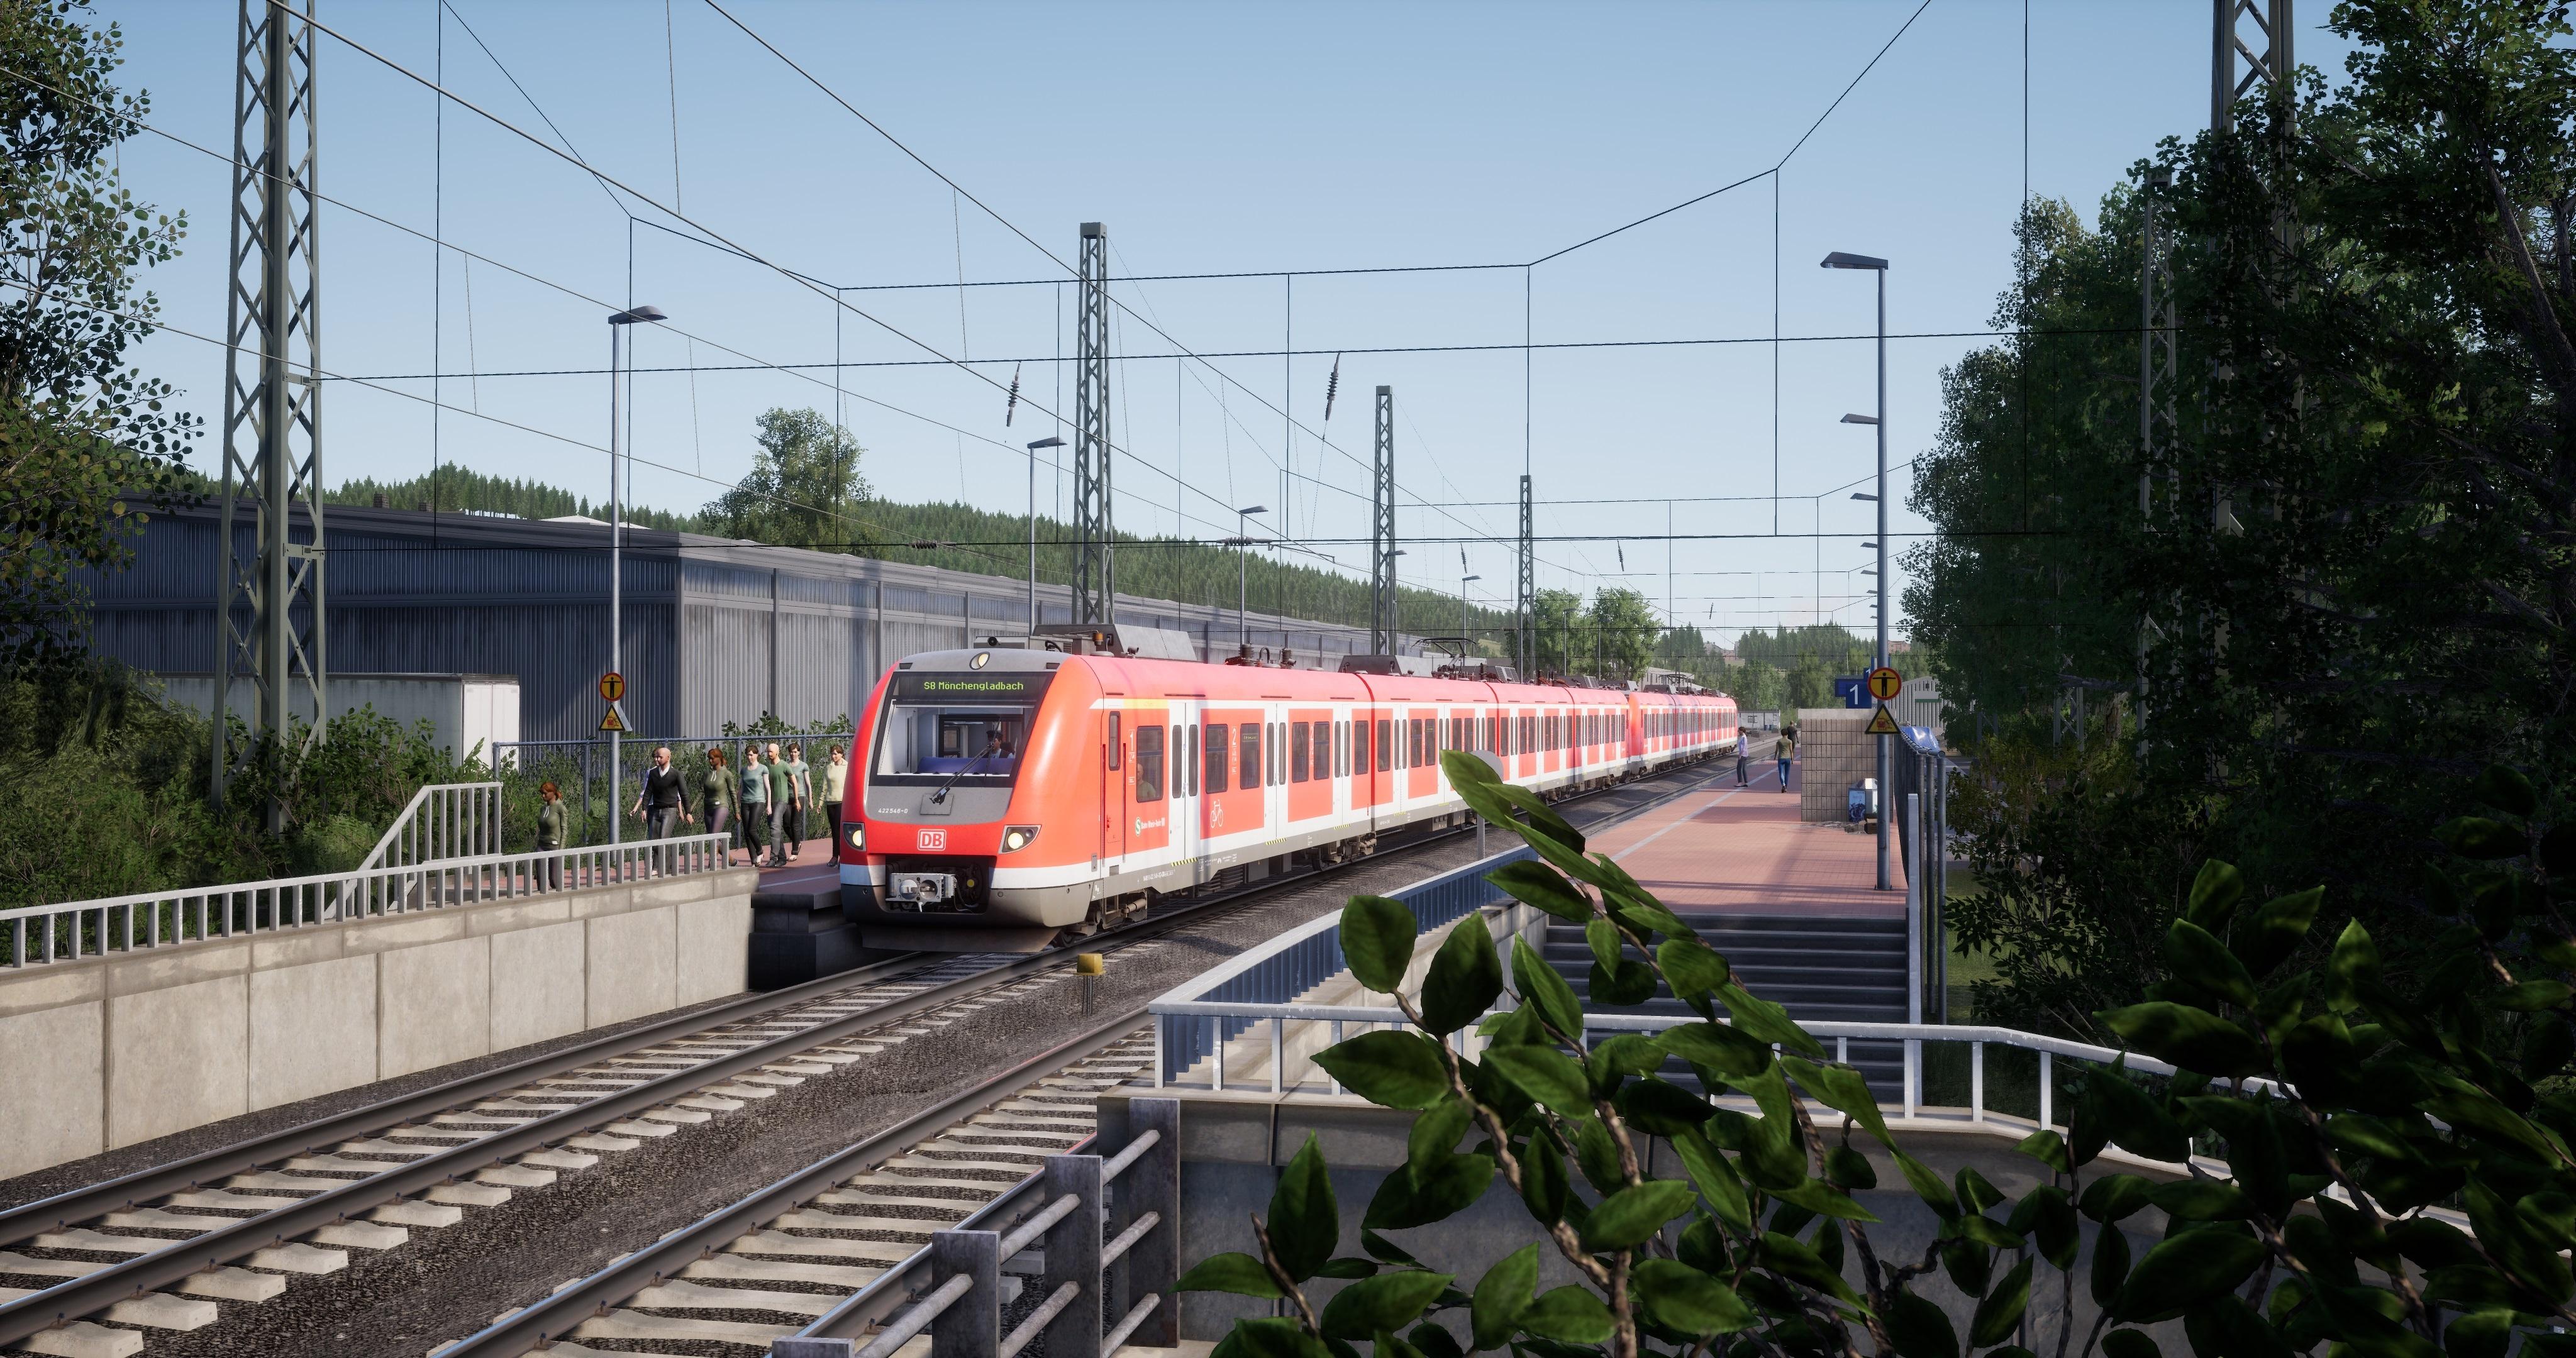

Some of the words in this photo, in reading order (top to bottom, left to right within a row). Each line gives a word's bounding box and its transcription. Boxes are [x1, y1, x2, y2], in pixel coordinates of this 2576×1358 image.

[924, 682, 936, 690] S8
[938, 682, 1024, 691] Mönchengladbach
[1850, 684, 1858, 705] 1
[1130, 731, 1133, 751] 1
[1232, 727, 1236, 746] 2
[921, 832, 943, 847] DB
